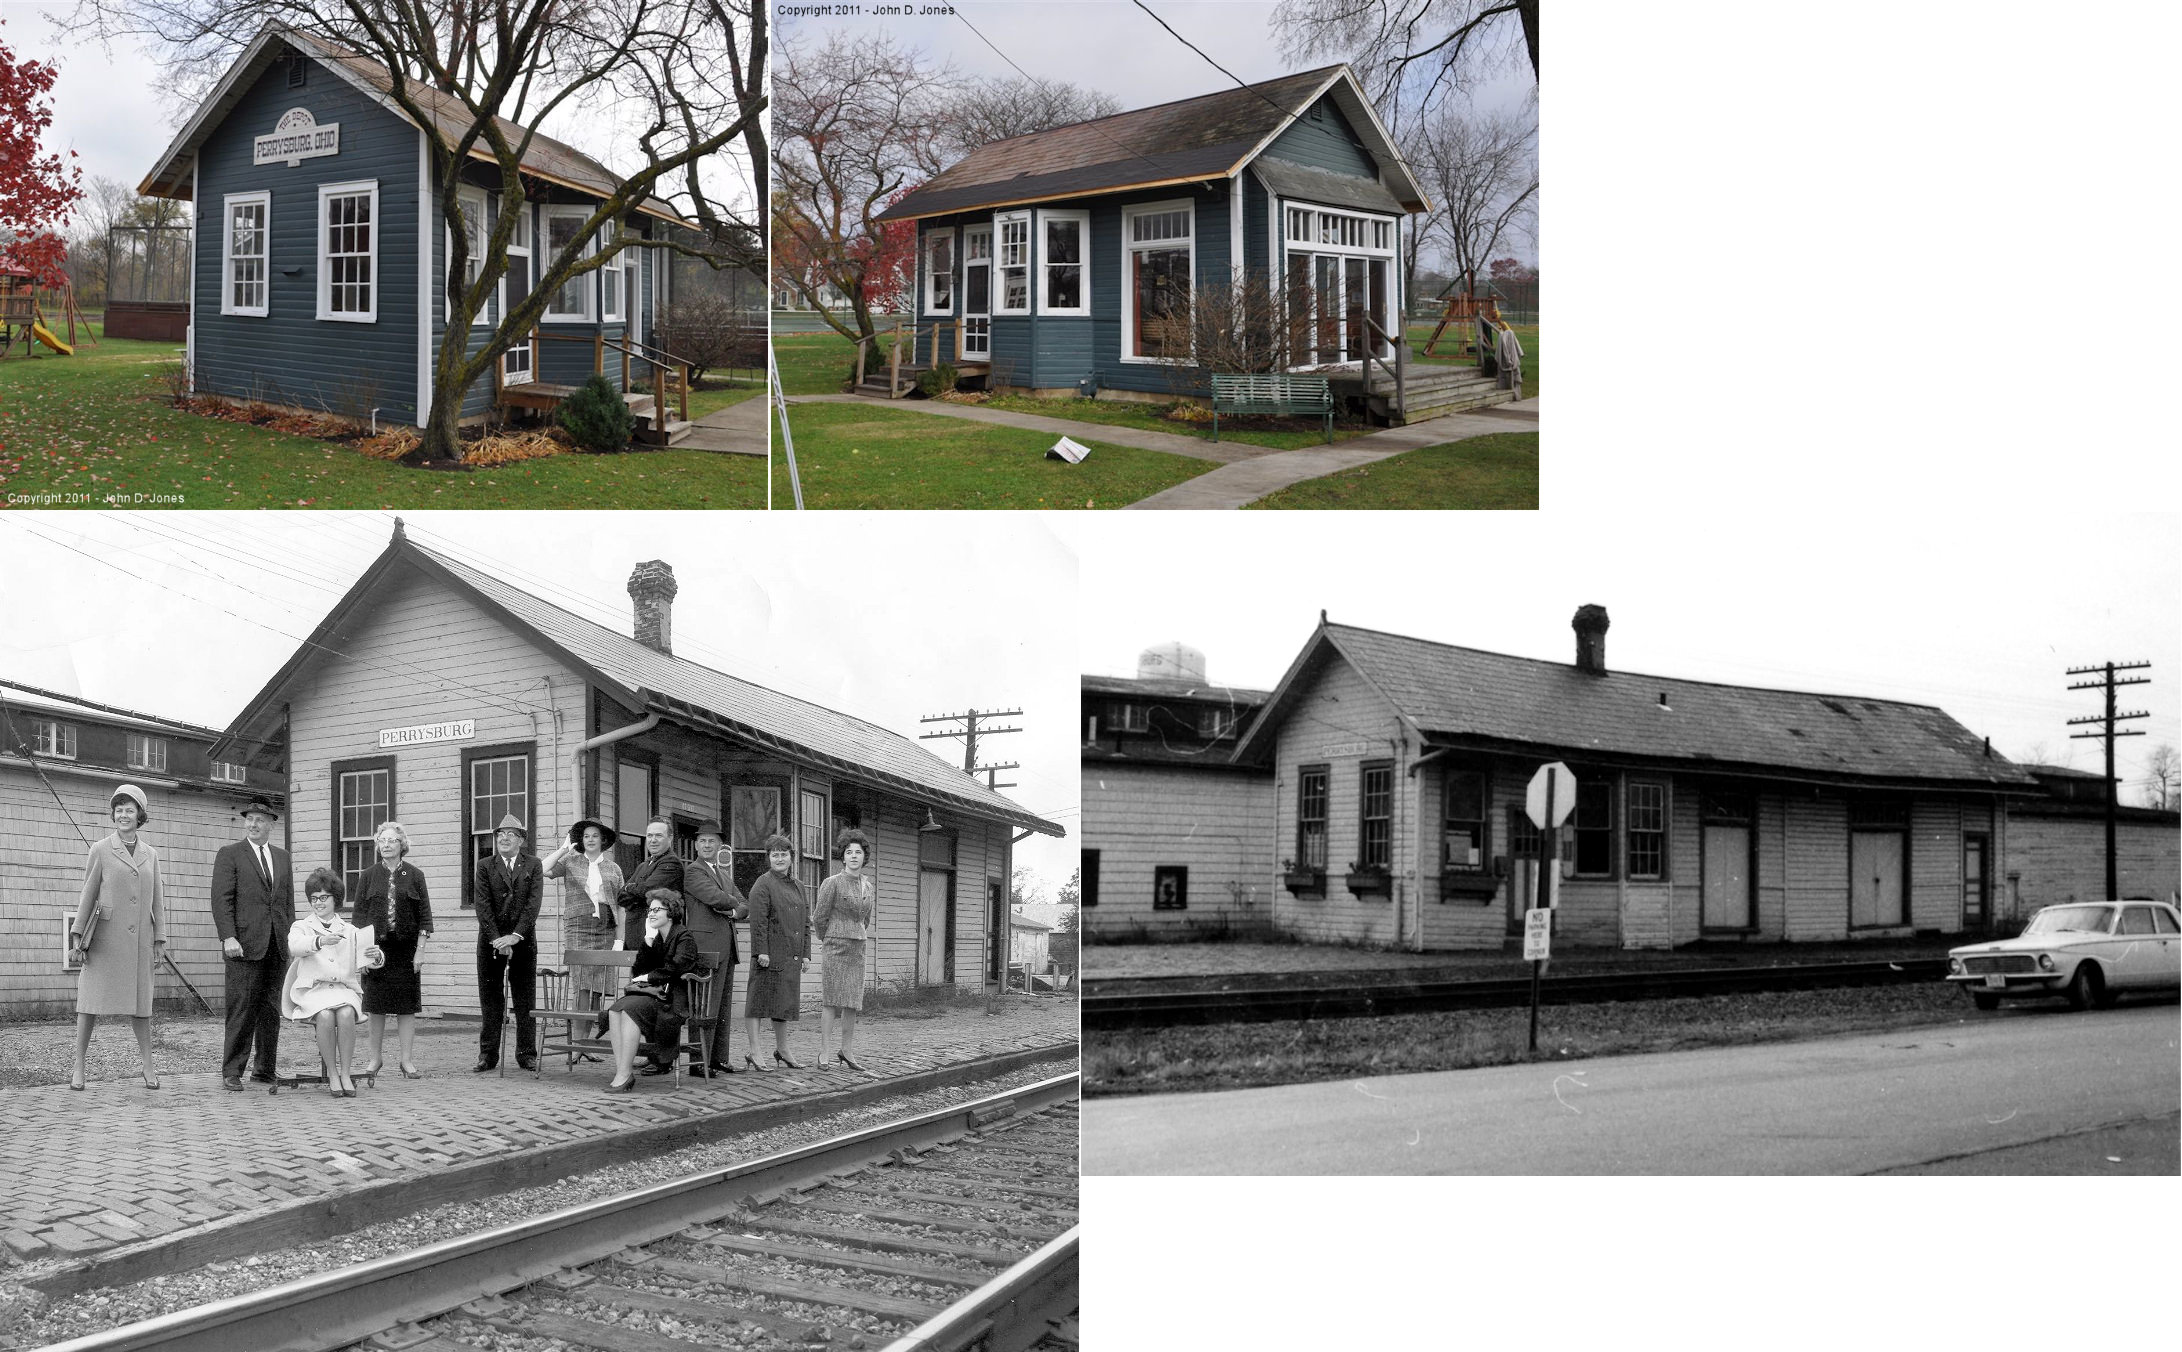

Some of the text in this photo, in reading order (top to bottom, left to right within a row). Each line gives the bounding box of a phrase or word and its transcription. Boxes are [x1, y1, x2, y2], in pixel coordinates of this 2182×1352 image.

[279, 111, 312, 131] THE DEPOT
[315, 130, 336, 150] OHIO
[381, 723, 472, 744] PERRYSBURG
[1532, 912, 1544, 922] NO
